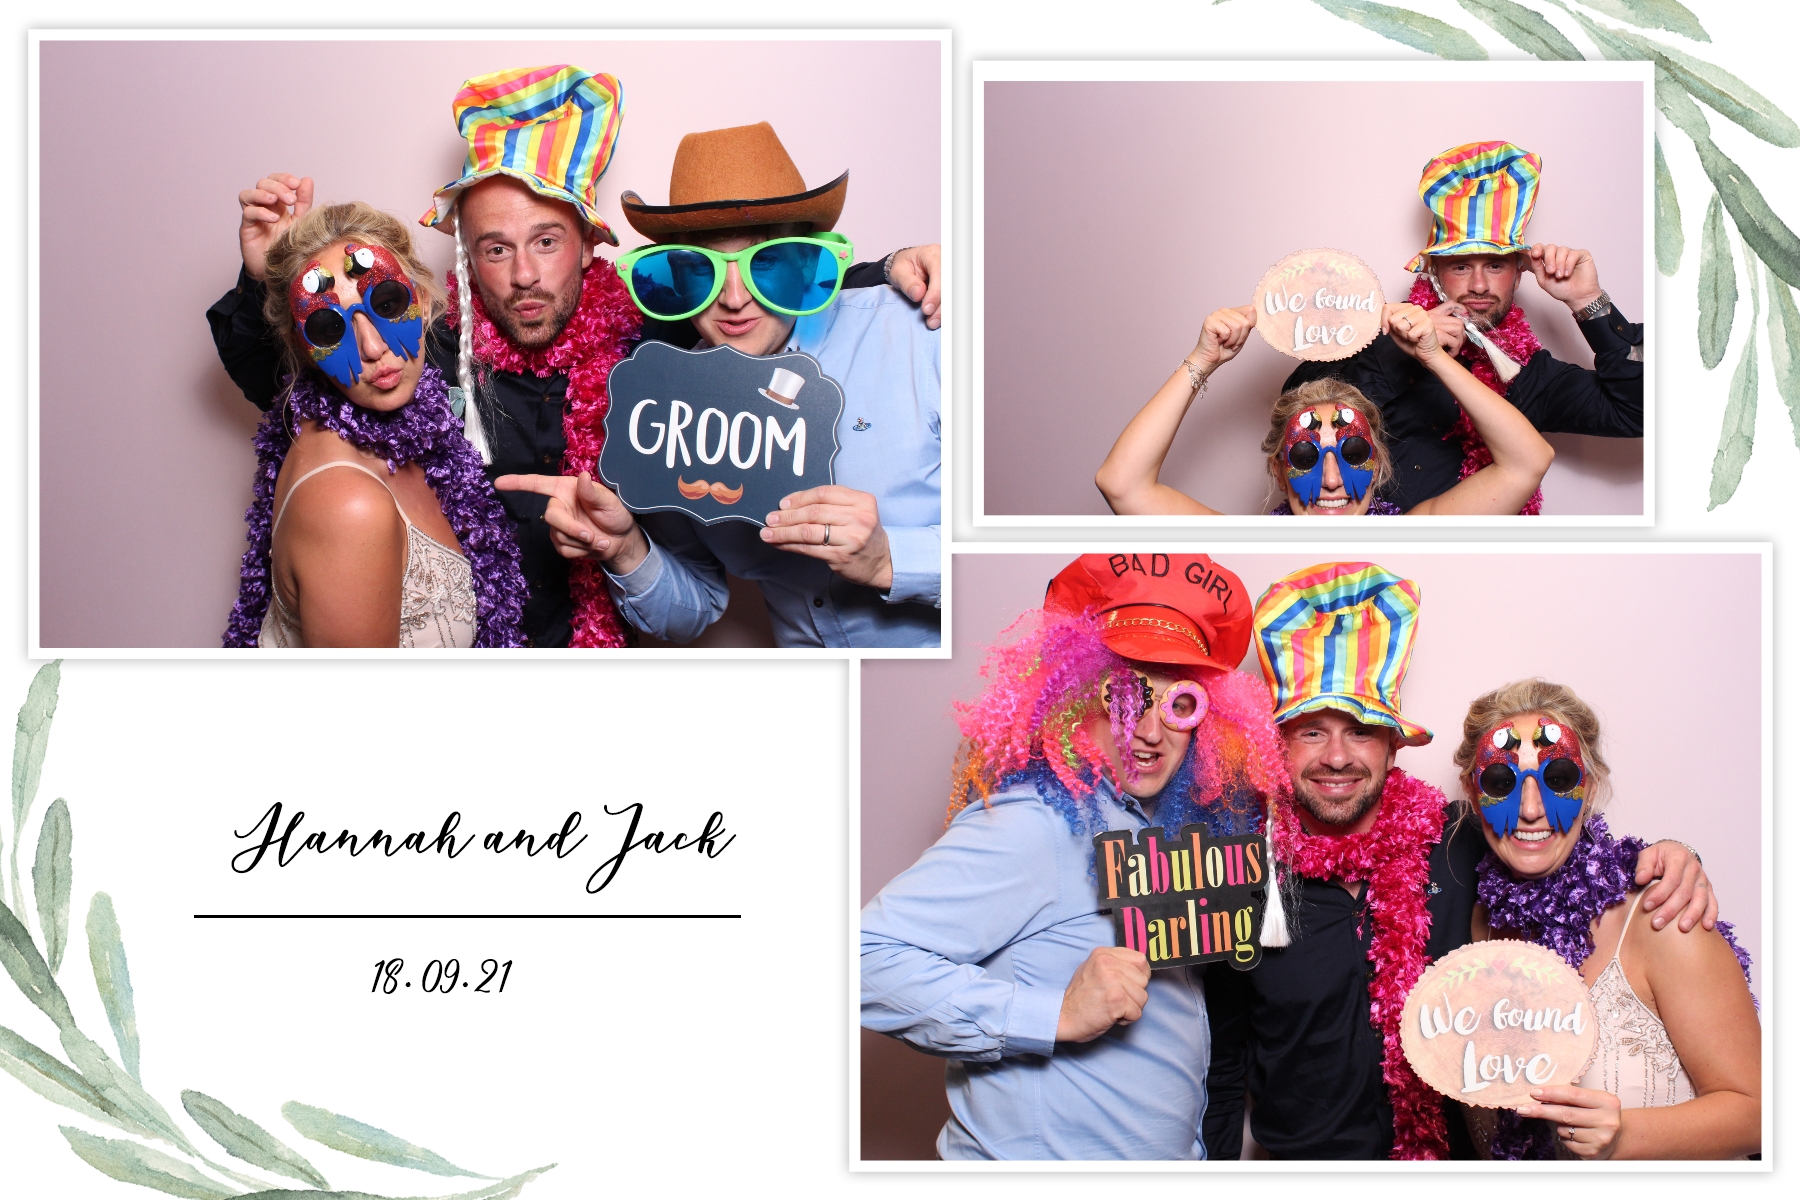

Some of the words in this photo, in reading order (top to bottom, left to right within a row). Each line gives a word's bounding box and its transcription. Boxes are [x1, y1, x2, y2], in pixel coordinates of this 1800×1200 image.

[1265, 283, 1307, 315] We
[1315, 287, 1379, 313] found
[1293, 315, 1359, 352] Love
[628, 398, 807, 477] GROOM
[1108, 553, 1170, 578] BAD
[1184, 562, 1233, 615] GIRL
[1101, 832, 1263, 900] Fabulous
[1120, 897, 1255, 963] Darling
[1419, 991, 1481, 1039] We
[1493, 998, 1588, 1036] found
[1460, 1040, 1559, 1093] Love
